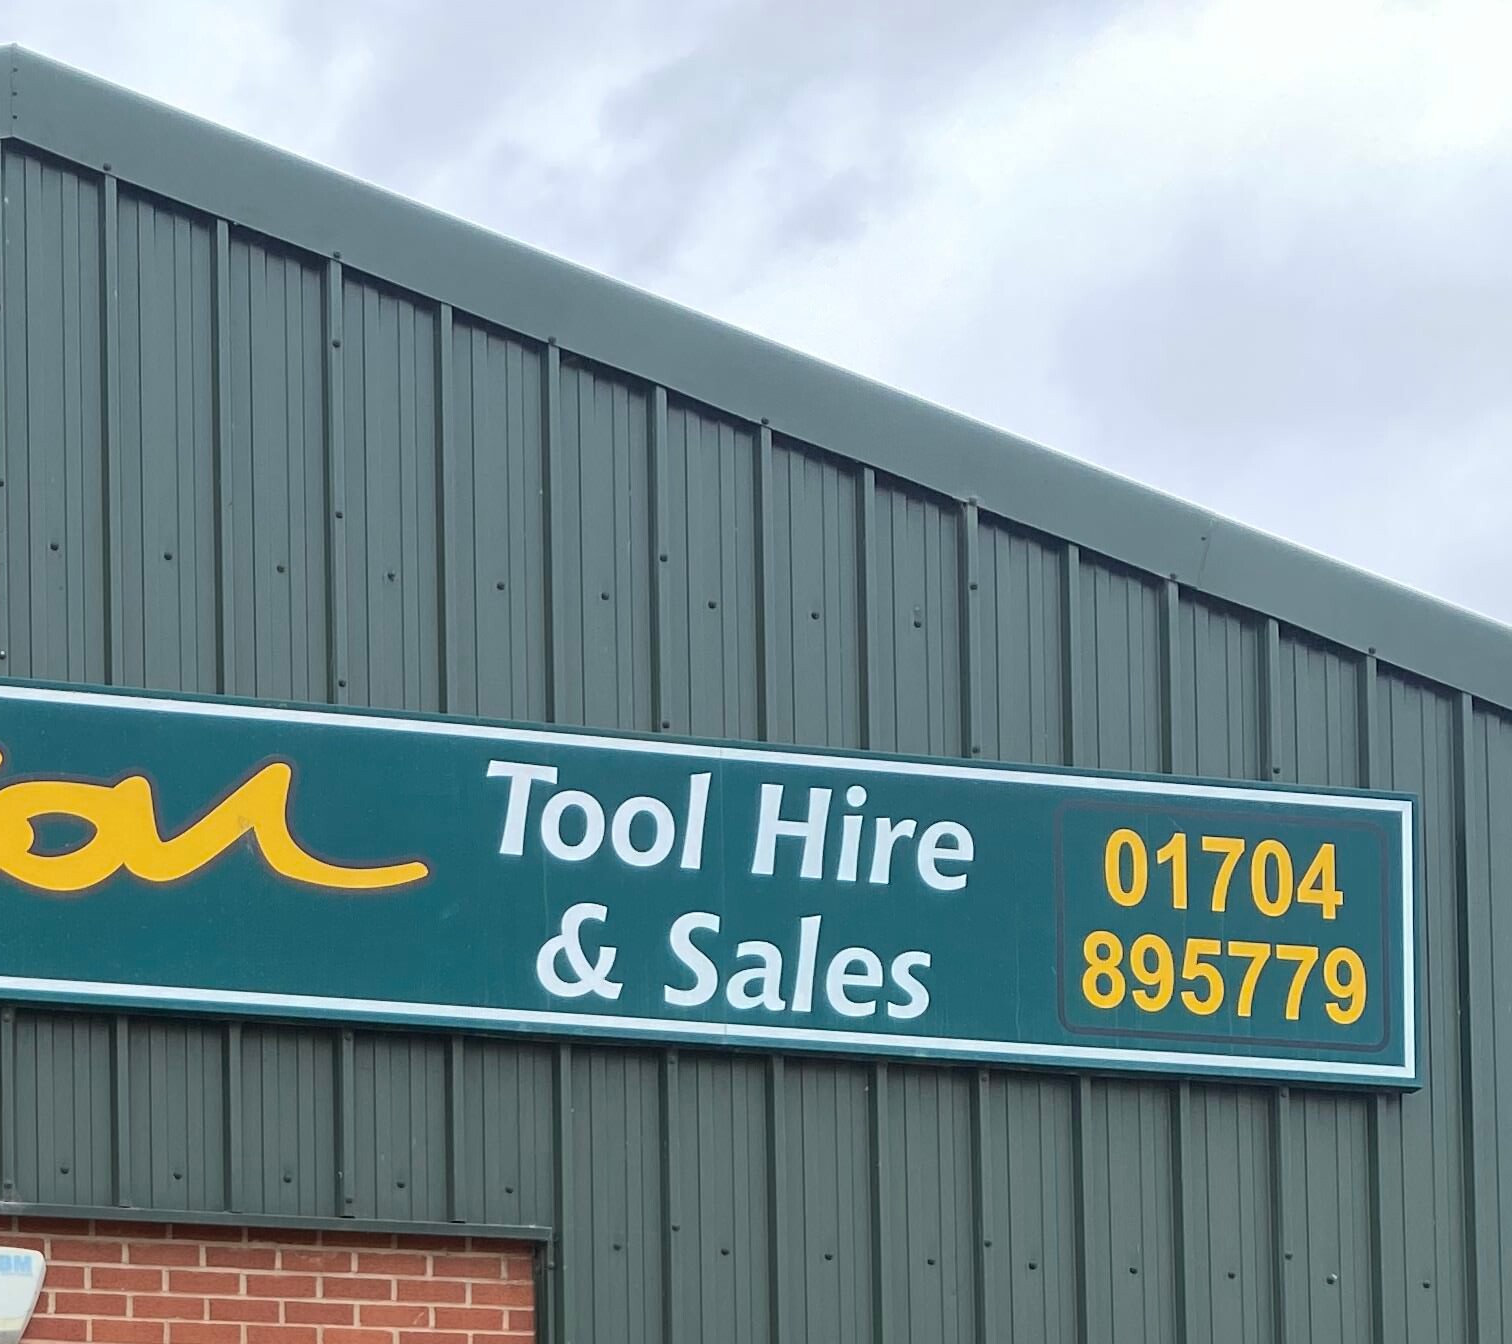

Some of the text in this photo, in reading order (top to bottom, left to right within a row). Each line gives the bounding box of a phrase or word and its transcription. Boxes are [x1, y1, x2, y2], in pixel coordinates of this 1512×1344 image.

[486, 760, 976, 891] Tool Hire
[1106, 830, 1341, 918] 01704
[536, 902, 931, 1019] & Sales
[1082, 932, 1365, 1023] 895779
